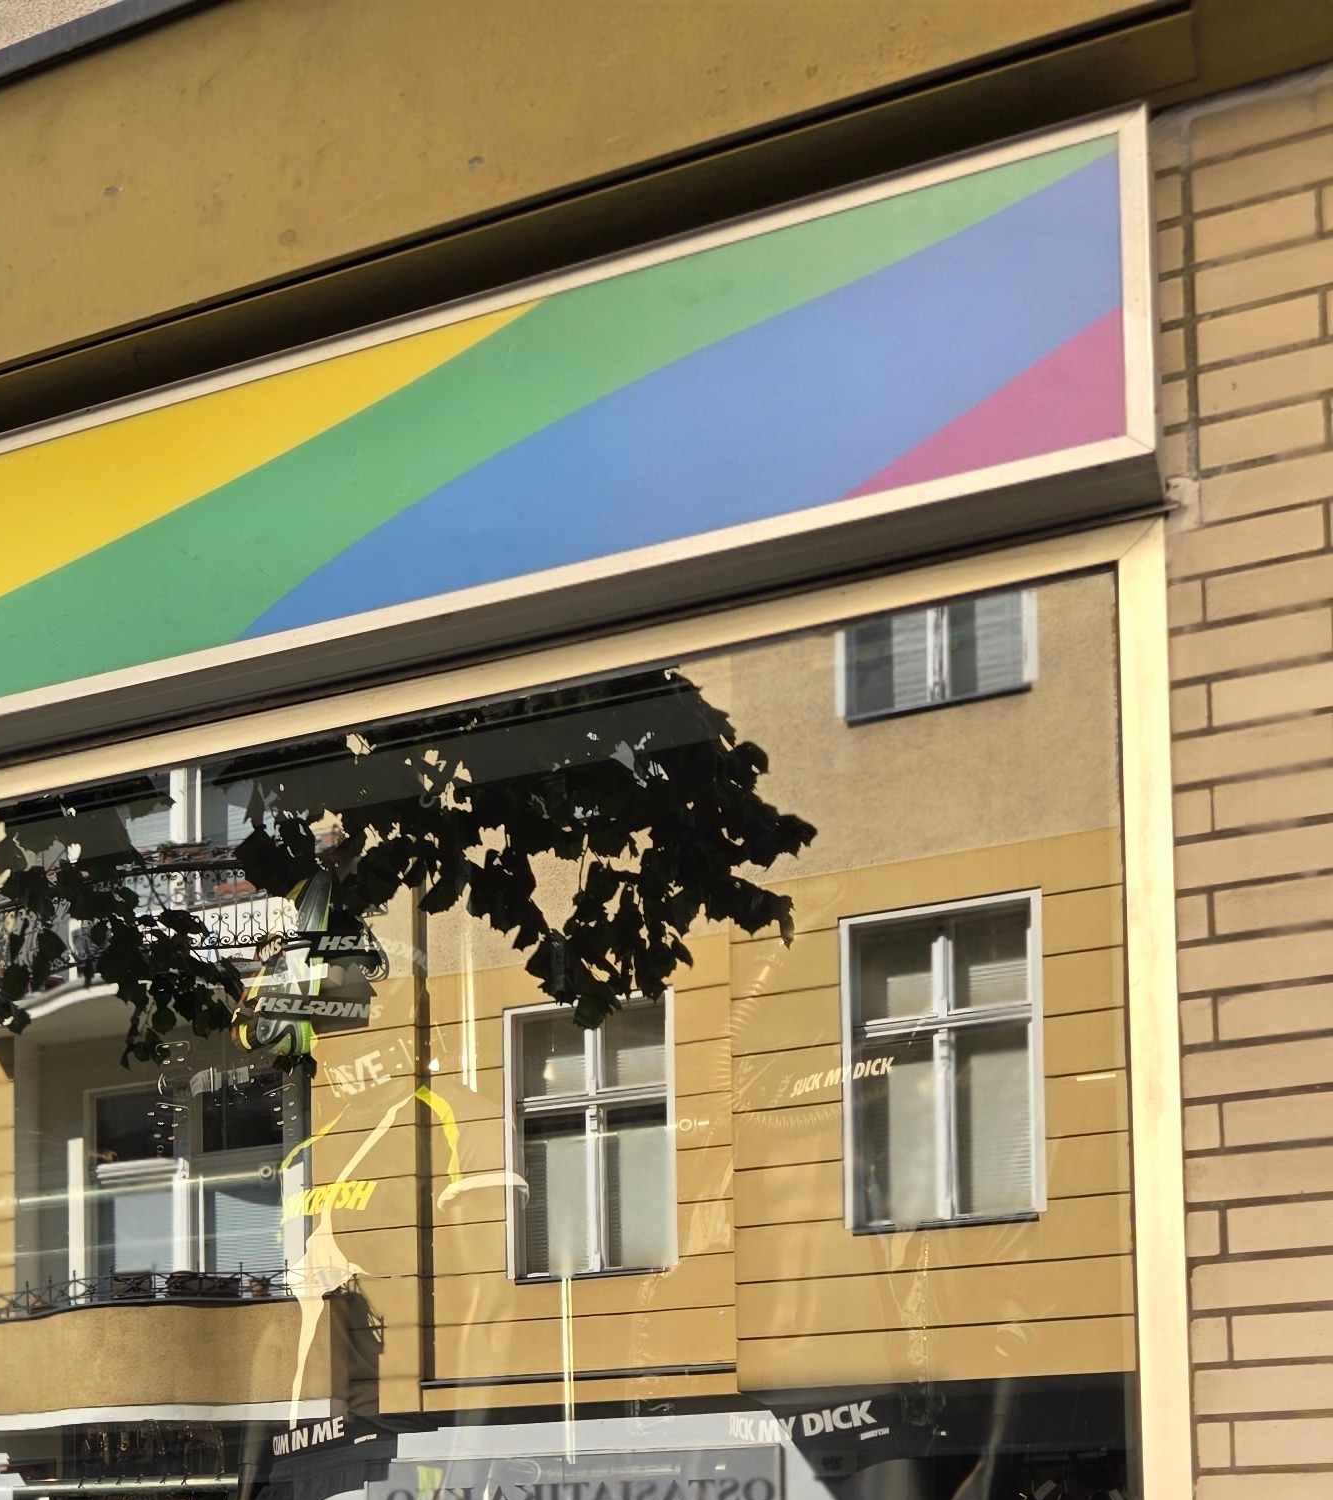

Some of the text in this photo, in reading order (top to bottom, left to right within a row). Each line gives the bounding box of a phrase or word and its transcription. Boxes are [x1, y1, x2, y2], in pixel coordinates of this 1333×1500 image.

[852, 1056, 895, 1081] DICK
[292, 1427, 309, 1452] IN
[311, 1415, 345, 1446] ME
[801, 1399, 877, 1438] DICK
